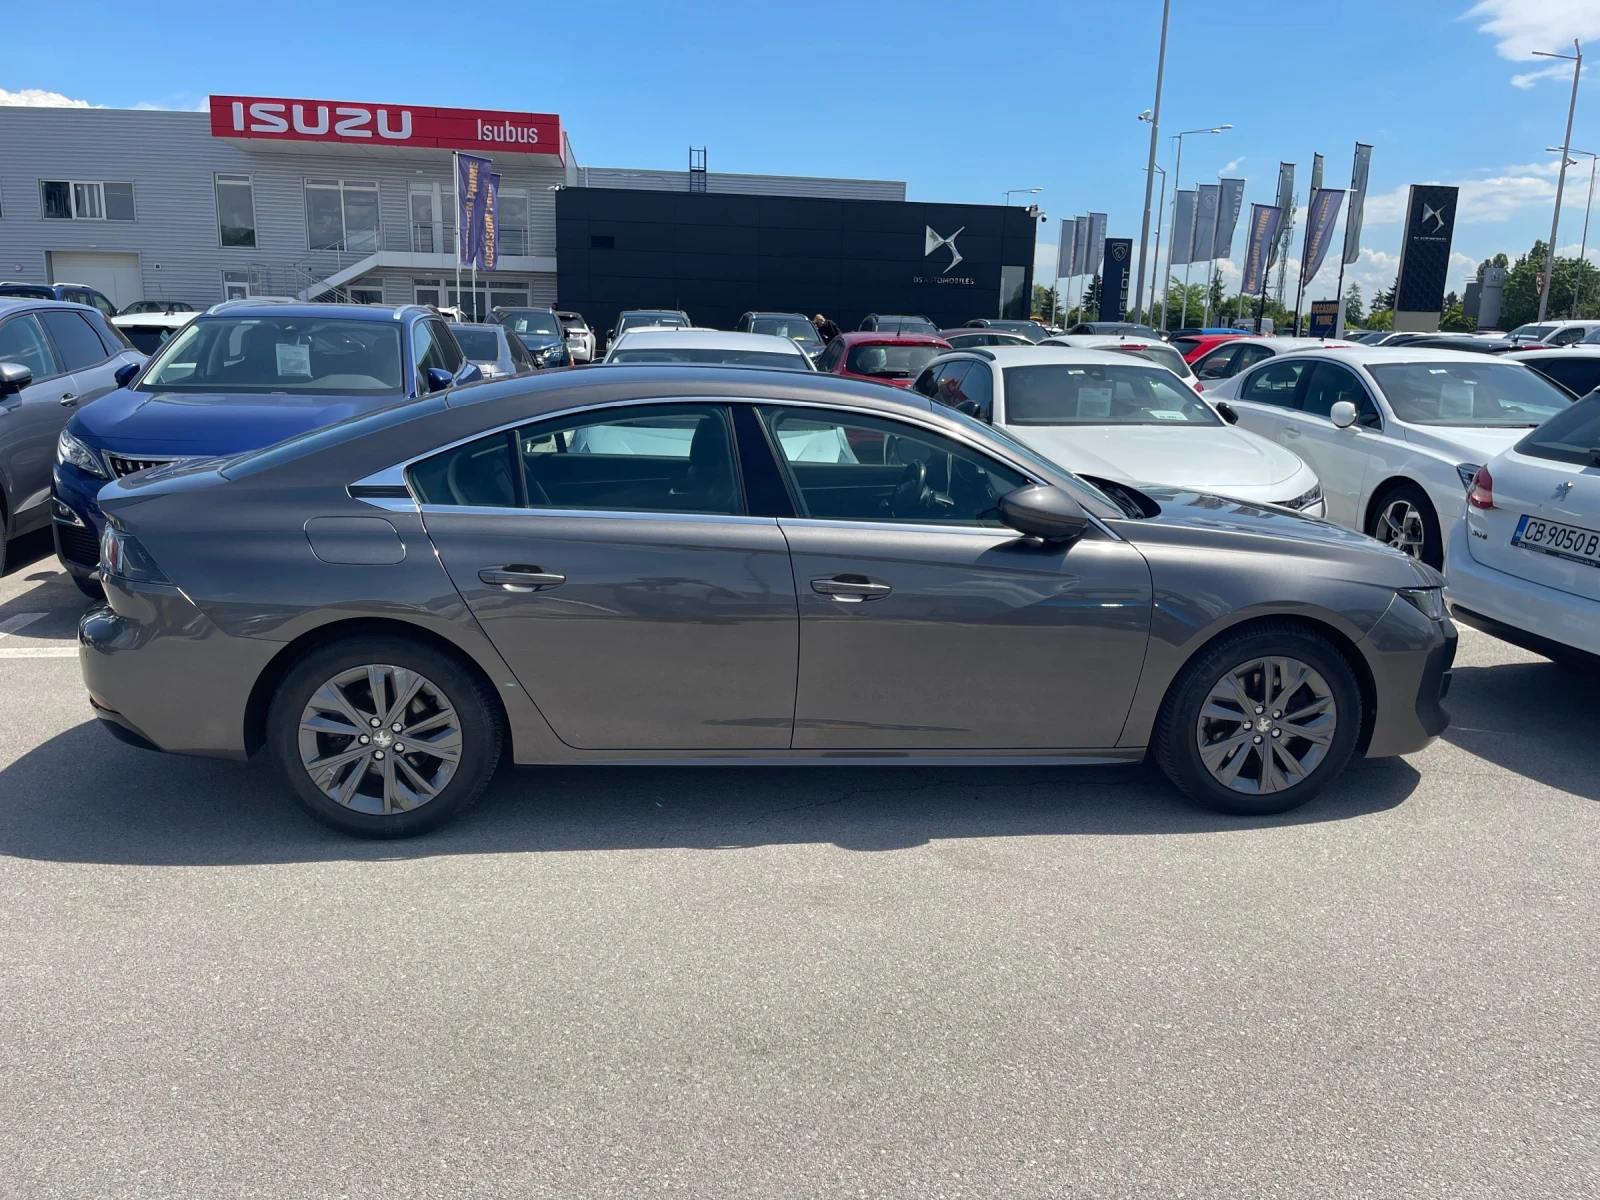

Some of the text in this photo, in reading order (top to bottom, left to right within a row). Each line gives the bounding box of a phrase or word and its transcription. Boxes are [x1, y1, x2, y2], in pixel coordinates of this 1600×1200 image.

[232, 101, 413, 140] ISUZU
[477, 118, 538, 144] Isubus
[468, 162, 479, 199] PRIME
[484, 213, 495, 267] OCCASION
[1248, 209, 1270, 290] OCCASION PRIME
[1117, 267, 1130, 323] UGEOT
[1525, 521, 1600, 558] CB 9050 B
